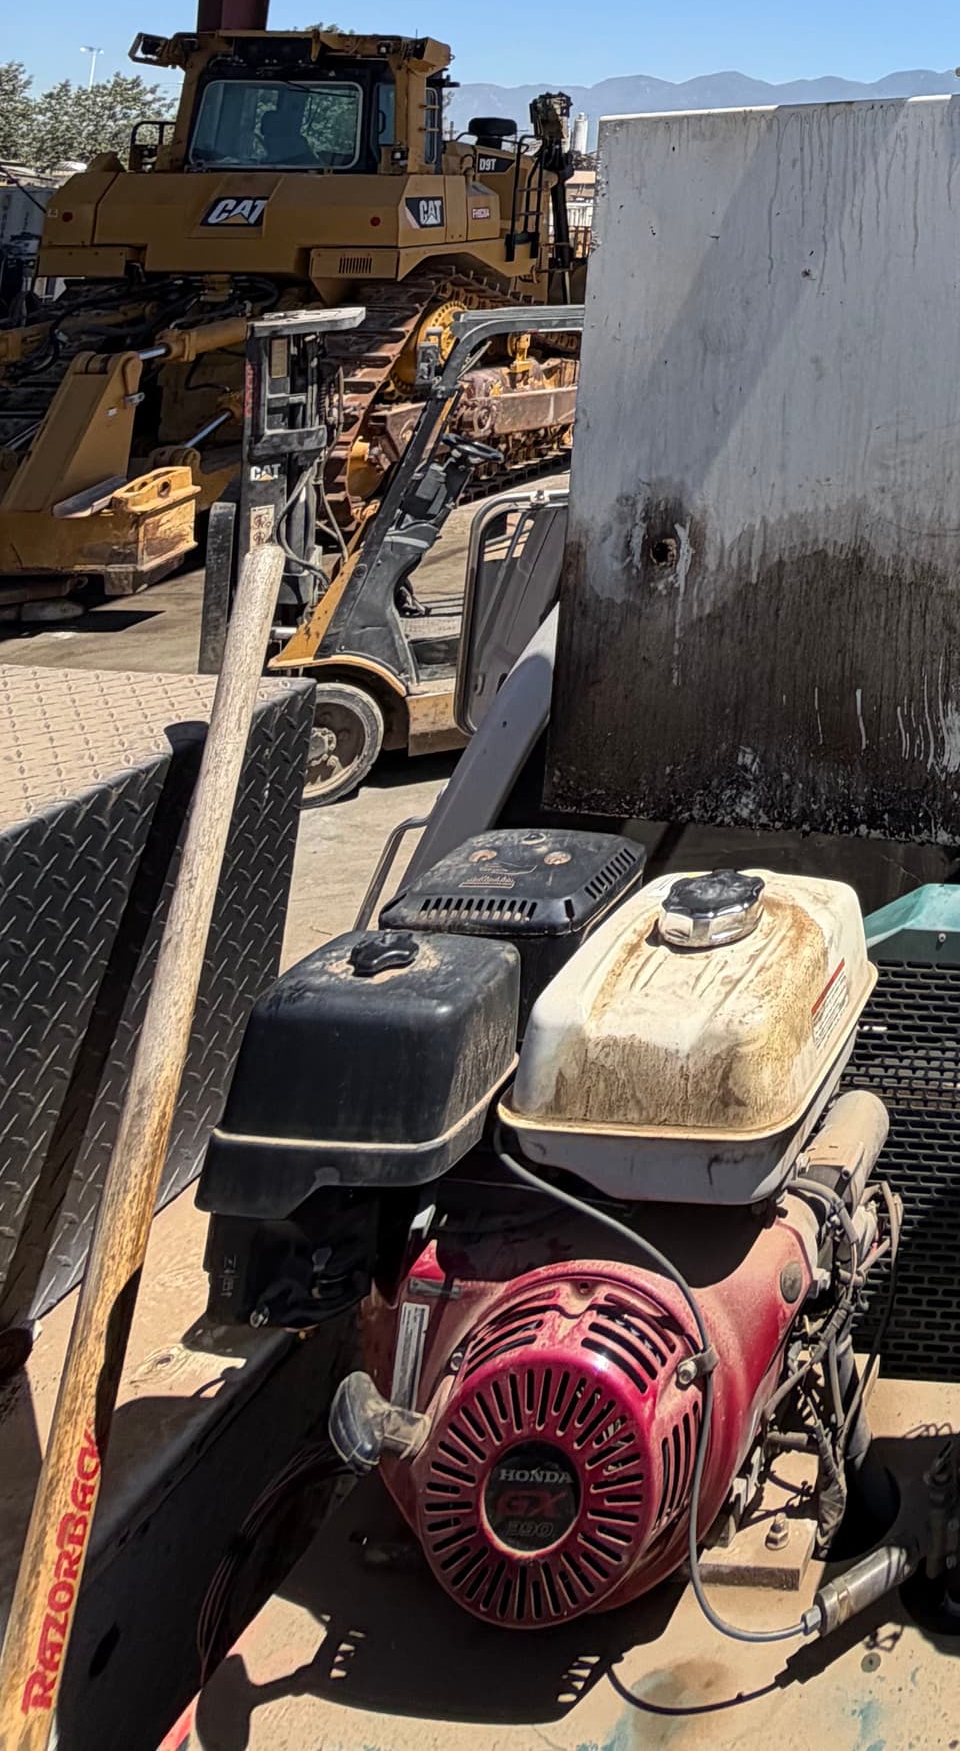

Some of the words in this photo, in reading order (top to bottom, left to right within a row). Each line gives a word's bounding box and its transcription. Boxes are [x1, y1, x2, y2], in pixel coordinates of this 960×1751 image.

[479, 158, 496, 171] D9T
[207, 198, 267, 225] CAT
[419, 199, 442, 225] CAT
[250, 463, 281, 481] CAT
[499, 1468, 574, 1483] HONDA
[496, 1489, 568, 1518] GX
